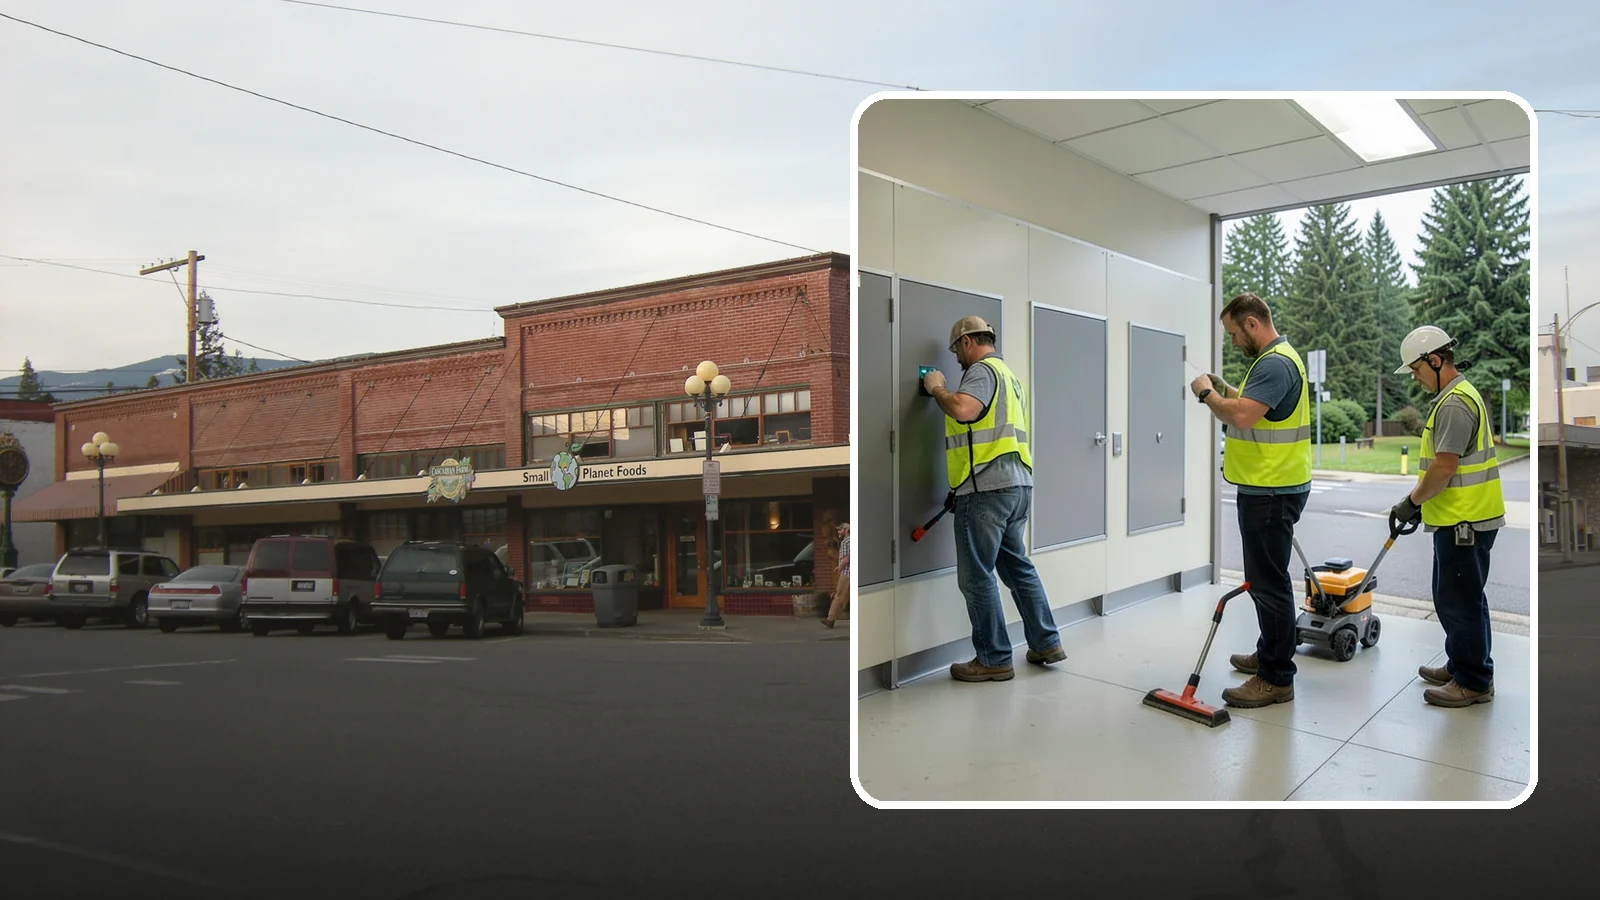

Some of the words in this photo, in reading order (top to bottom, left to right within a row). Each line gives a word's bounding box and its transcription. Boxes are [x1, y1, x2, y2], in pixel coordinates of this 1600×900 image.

[523, 471, 549, 483] Small
[583, 467, 614, 479] Planet
[617, 464, 647, 477] Foods
